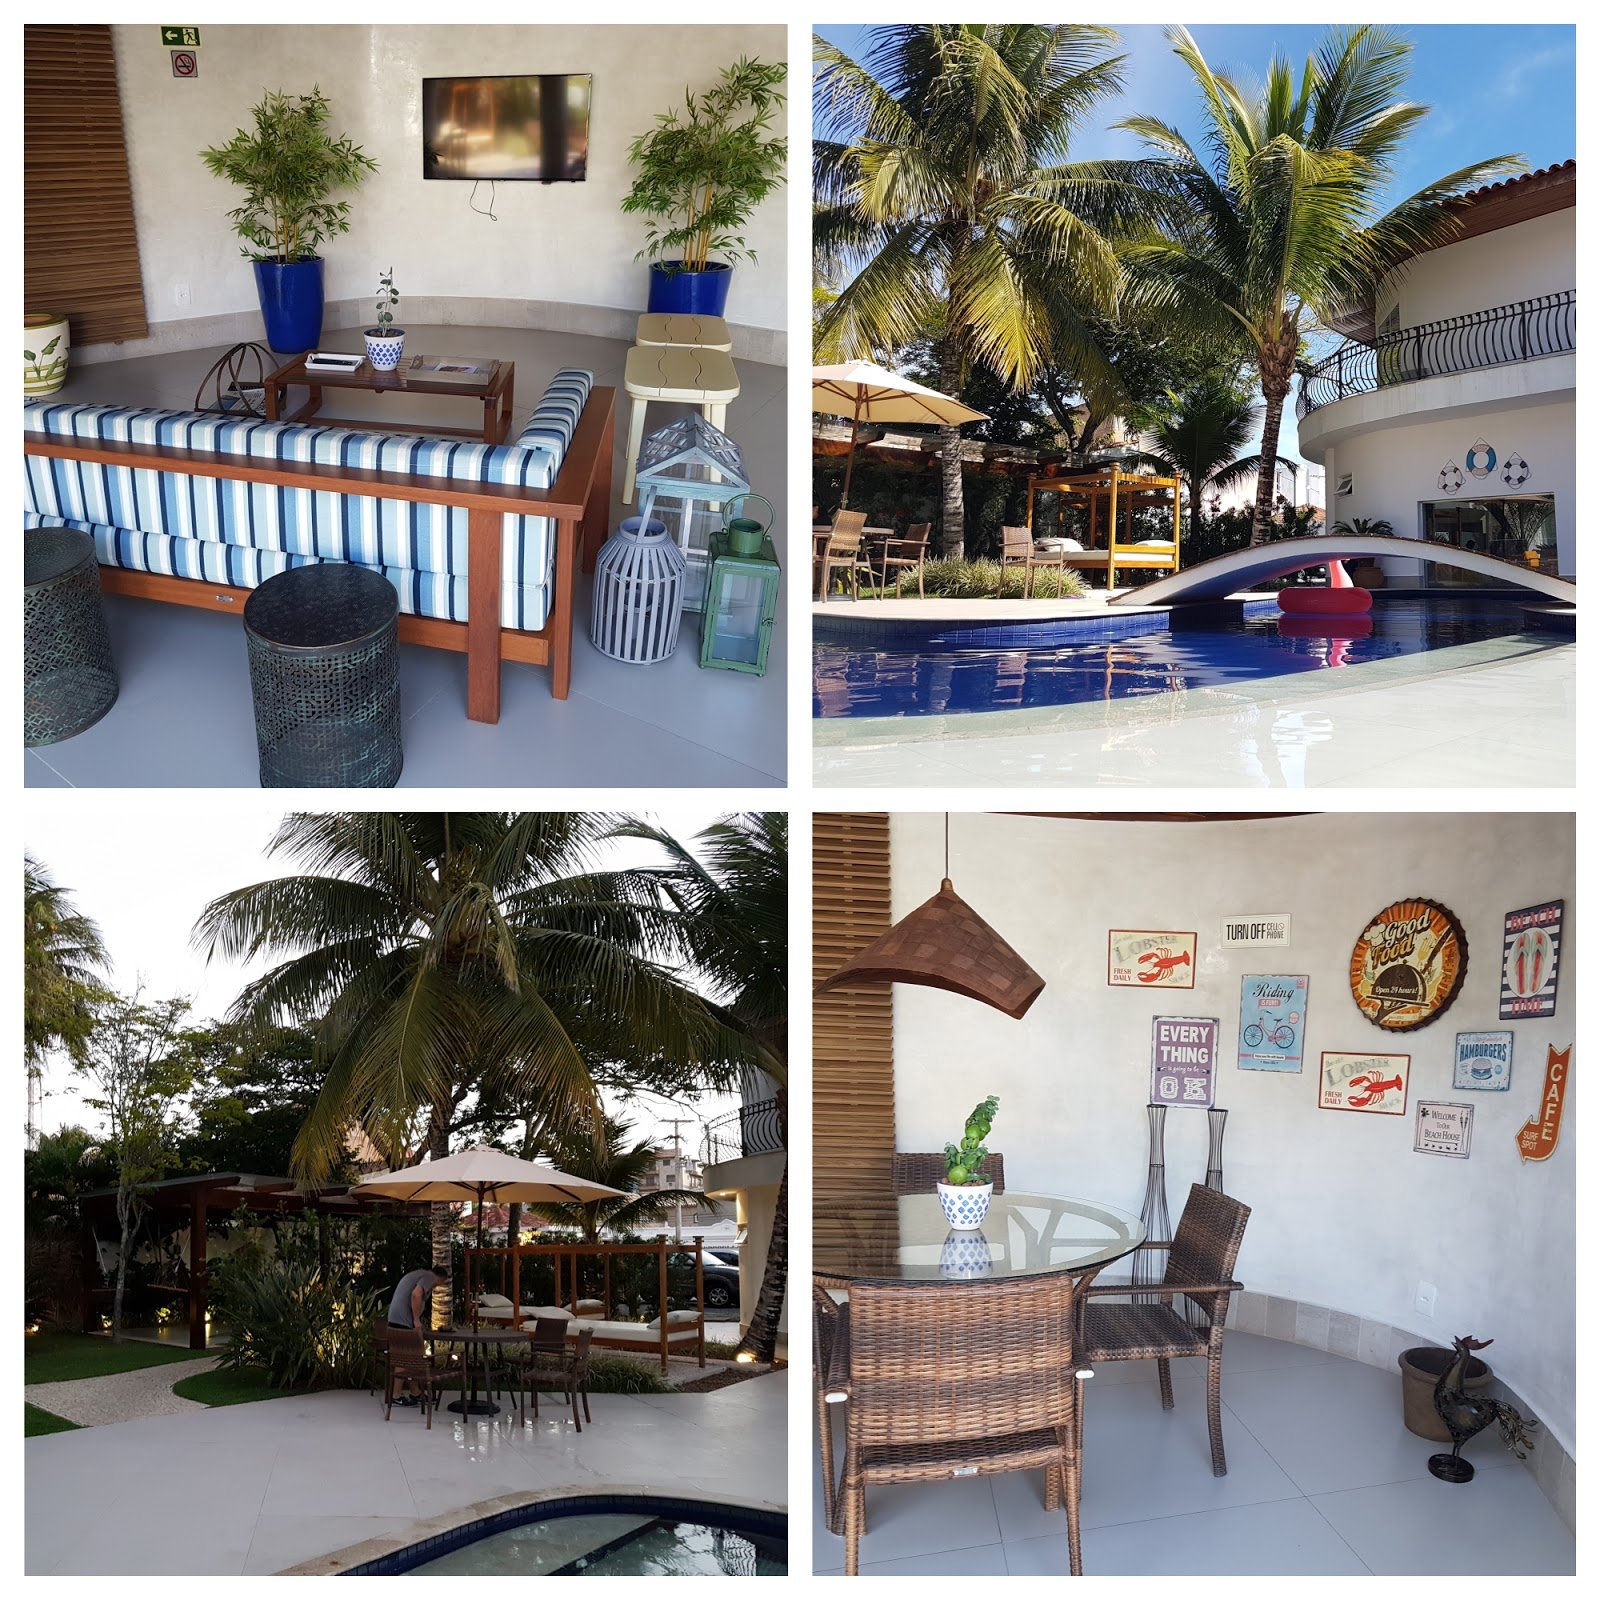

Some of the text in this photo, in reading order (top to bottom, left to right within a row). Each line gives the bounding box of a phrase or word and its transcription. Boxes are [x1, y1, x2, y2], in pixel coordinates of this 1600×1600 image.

[1266, 922, 1278, 931] CELL
[1384, 907, 1431, 948] Good
[1510, 906, 1557, 932] BEACH
[1226, 923, 1266, 940] TURN OFF
[1266, 930, 1284, 939] PHONE
[1371, 931, 1415, 970] Food
[1113, 974, 1132, 982] DAILY
[1252, 982, 1295, 1004] Riding
[1375, 986, 1390, 994] Open
[1390, 986, 1398, 994] 24
[1510, 998, 1544, 1015] TIME
[1160, 1025, 1210, 1044] EVERY
[1160, 1045, 1209, 1064] THING
[1459, 1043, 1507, 1062] HAMBURGERS
[1172, 1067, 1187, 1075] going
[1541, 1063, 1563, 1141] CAFE
[1523, 1131, 1539, 1140] SURF
[1521, 1140, 1537, 1150] SPOT
